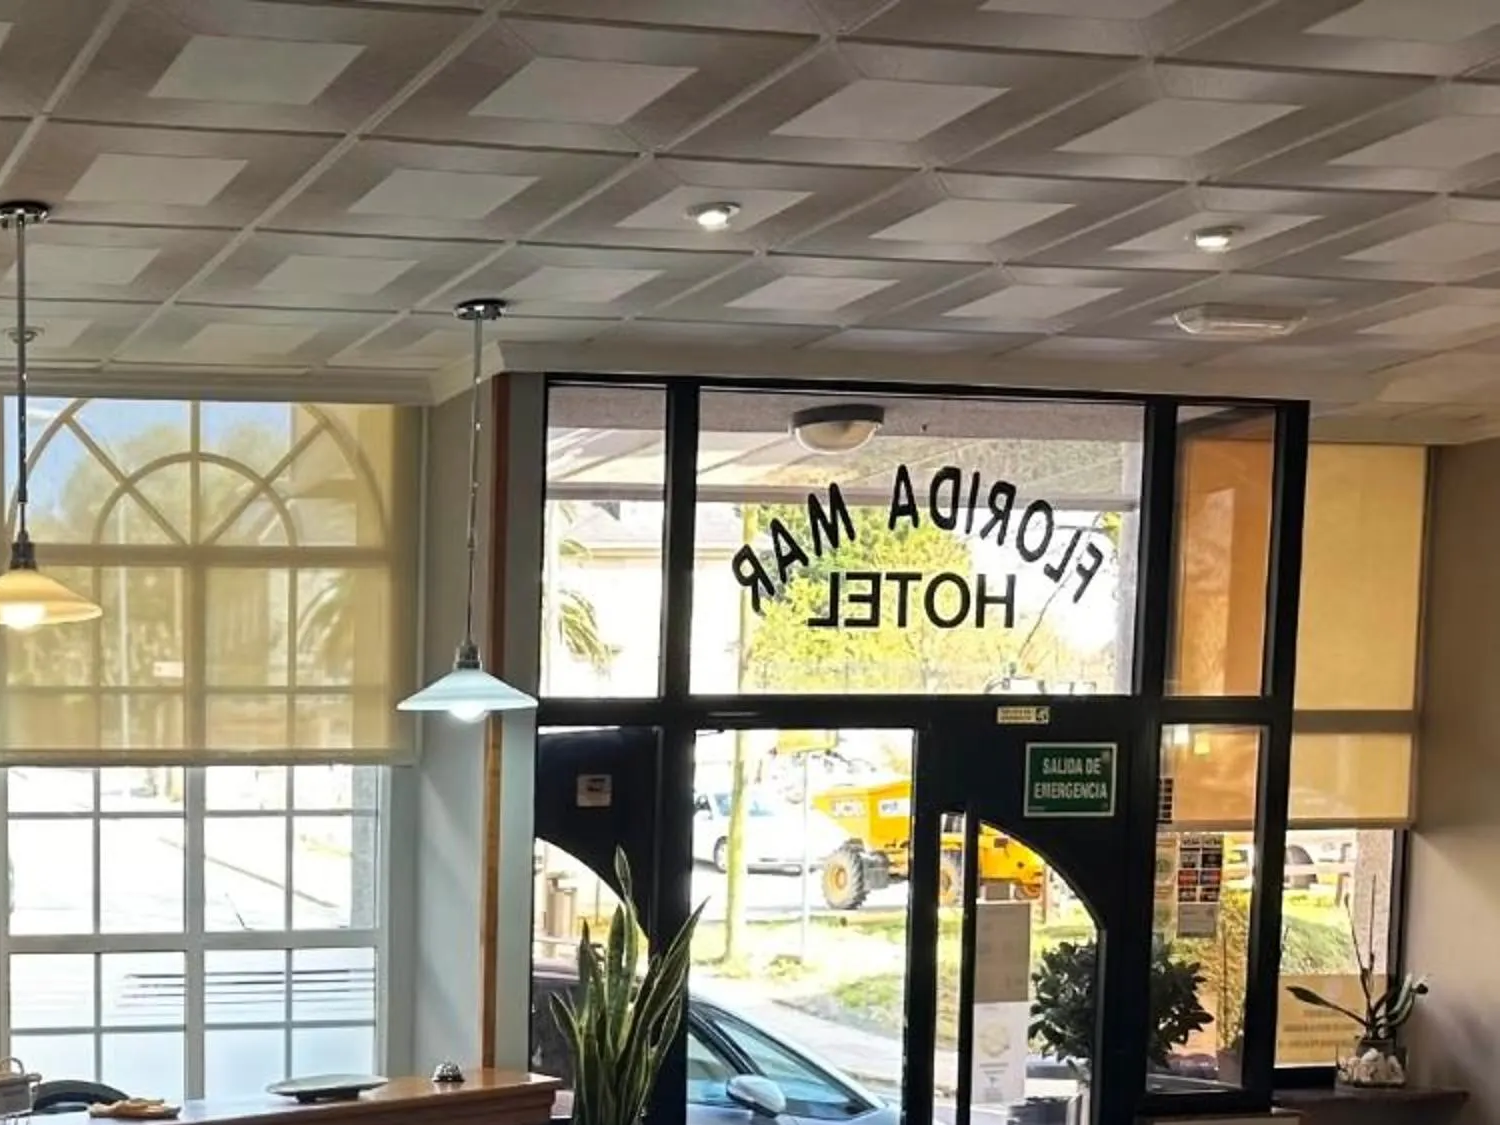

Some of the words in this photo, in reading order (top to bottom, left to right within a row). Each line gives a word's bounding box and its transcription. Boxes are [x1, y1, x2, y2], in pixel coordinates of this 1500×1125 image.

[1042, 757, 1083, 775] SALIDA
[1085, 757, 1101, 775] DE
[1033, 781, 1108, 799] EMERGENCIA
